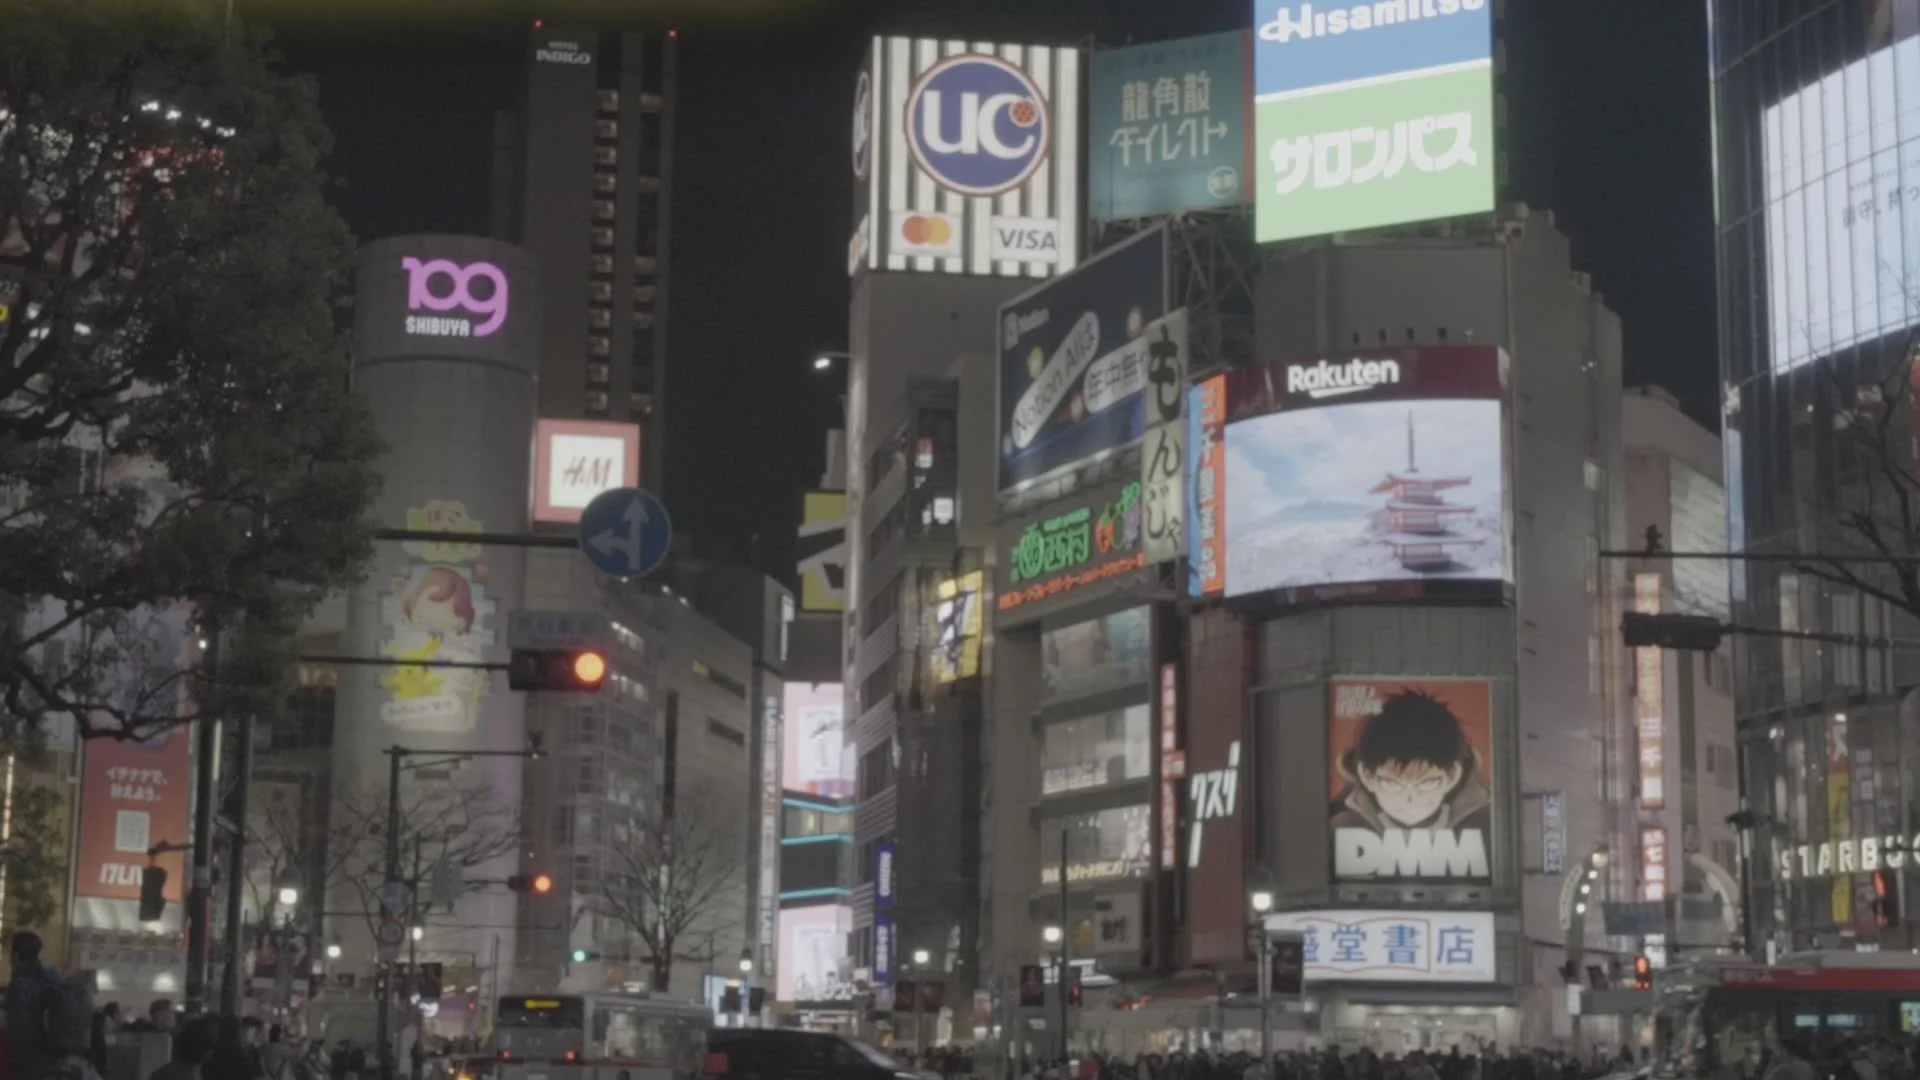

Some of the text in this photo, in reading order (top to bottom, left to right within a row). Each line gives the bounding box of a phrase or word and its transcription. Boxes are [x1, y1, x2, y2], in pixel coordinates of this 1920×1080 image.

[536, 49, 592, 64] INDIGO
[1121, 70, 1211, 122] 龍角散
[1269, 110, 1478, 195] サロンパス
[1000, 227, 1057, 249] VISA
[402, 256, 509, 337] 109
[405, 316, 470, 337] SHIBUYA
[1087, 349, 1147, 401] 年中無
[1287, 358, 1400, 393] Rakuten
[1334, 827, 1489, 879] DMM
